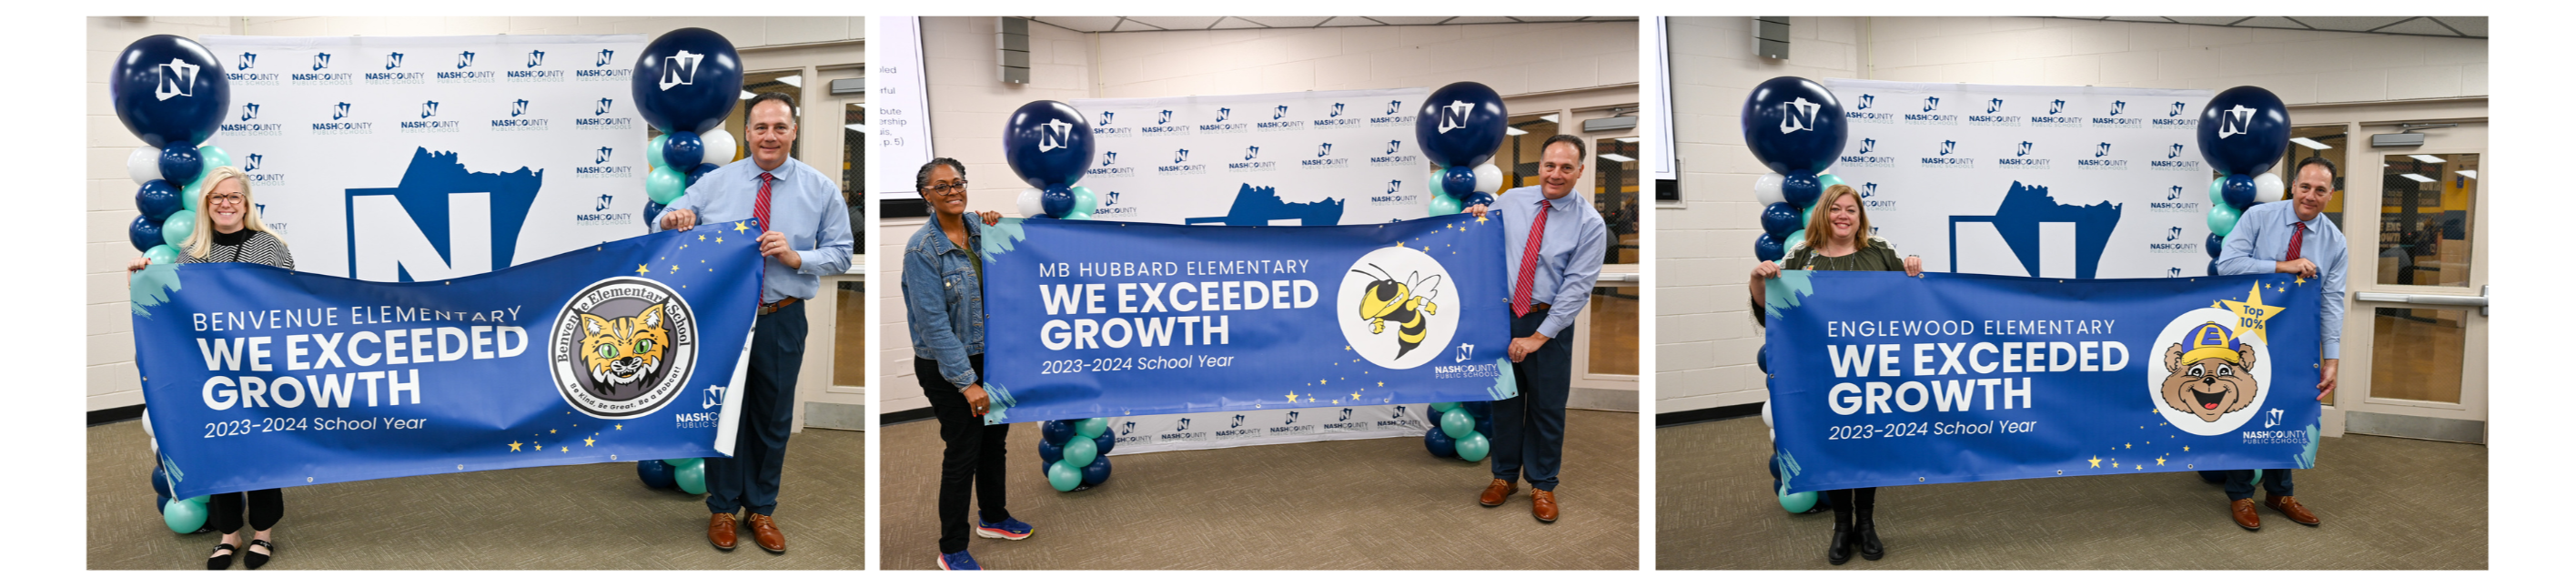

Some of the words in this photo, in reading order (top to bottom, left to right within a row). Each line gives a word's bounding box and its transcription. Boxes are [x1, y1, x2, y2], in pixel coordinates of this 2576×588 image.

[292, 73, 352, 81] NASHCOUNTY
[365, 72, 425, 80] NASHCOUNTY
[437, 71, 495, 79] NASHCOUNTY
[312, 122, 372, 130] NASHCOUNTY
[401, 120, 460, 128] NASHCOUNTY
[1039, 262, 1070, 278] MB
[1080, 261, 1178, 277] HUBBARD
[1187, 259, 1309, 276] ELEMENTARY
[1039, 283, 1106, 315] WE
[1118, 279, 1319, 313] EXCEEDED
[193, 307, 338, 331] BENVENUE
[351, 305, 521, 325] ELEMENTARY
[2243, 305, 2265, 320] Top
[668, 304, 691, 346] School
[1040, 315, 1229, 351] GROWTH
[1828, 320, 1975, 338] ENGLEWOOD
[1984, 319, 2116, 335] ELEMENTARY
[2239, 318, 2264, 330] 10%
[2201, 324, 2222, 346] E
[196, 336, 273, 371] WE
[286, 325, 530, 370] EXCEEDED
[1041, 358, 1133, 374] 2023-2024
[1137, 355, 1194, 370] School
[1198, 353, 1235, 368] Year
[1434, 363, 1498, 374] NASHCOUNTY
[1827, 343, 1902, 378] WE
[1914, 340, 2130, 376] EXCEEDED
[201, 369, 421, 411] GROWTH
[570, 382, 580, 393] Be
[578, 393, 595, 407] Kind,
[638, 397, 650, 406] Be
[657, 366, 682, 395] Bobcat!
[1828, 377, 2032, 416] GROWTH
[204, 418, 308, 439] 2023-2024
[314, 416, 377, 431] School
[383, 417, 427, 430] Year
[676, 421, 710, 429] PUBLIC
[1828, 422, 1928, 441] 2023-2024
[1933, 420, 1994, 437] School
[1998, 419, 2037, 434] Year
[2243, 430, 2307, 441] NASHCOUNTY
